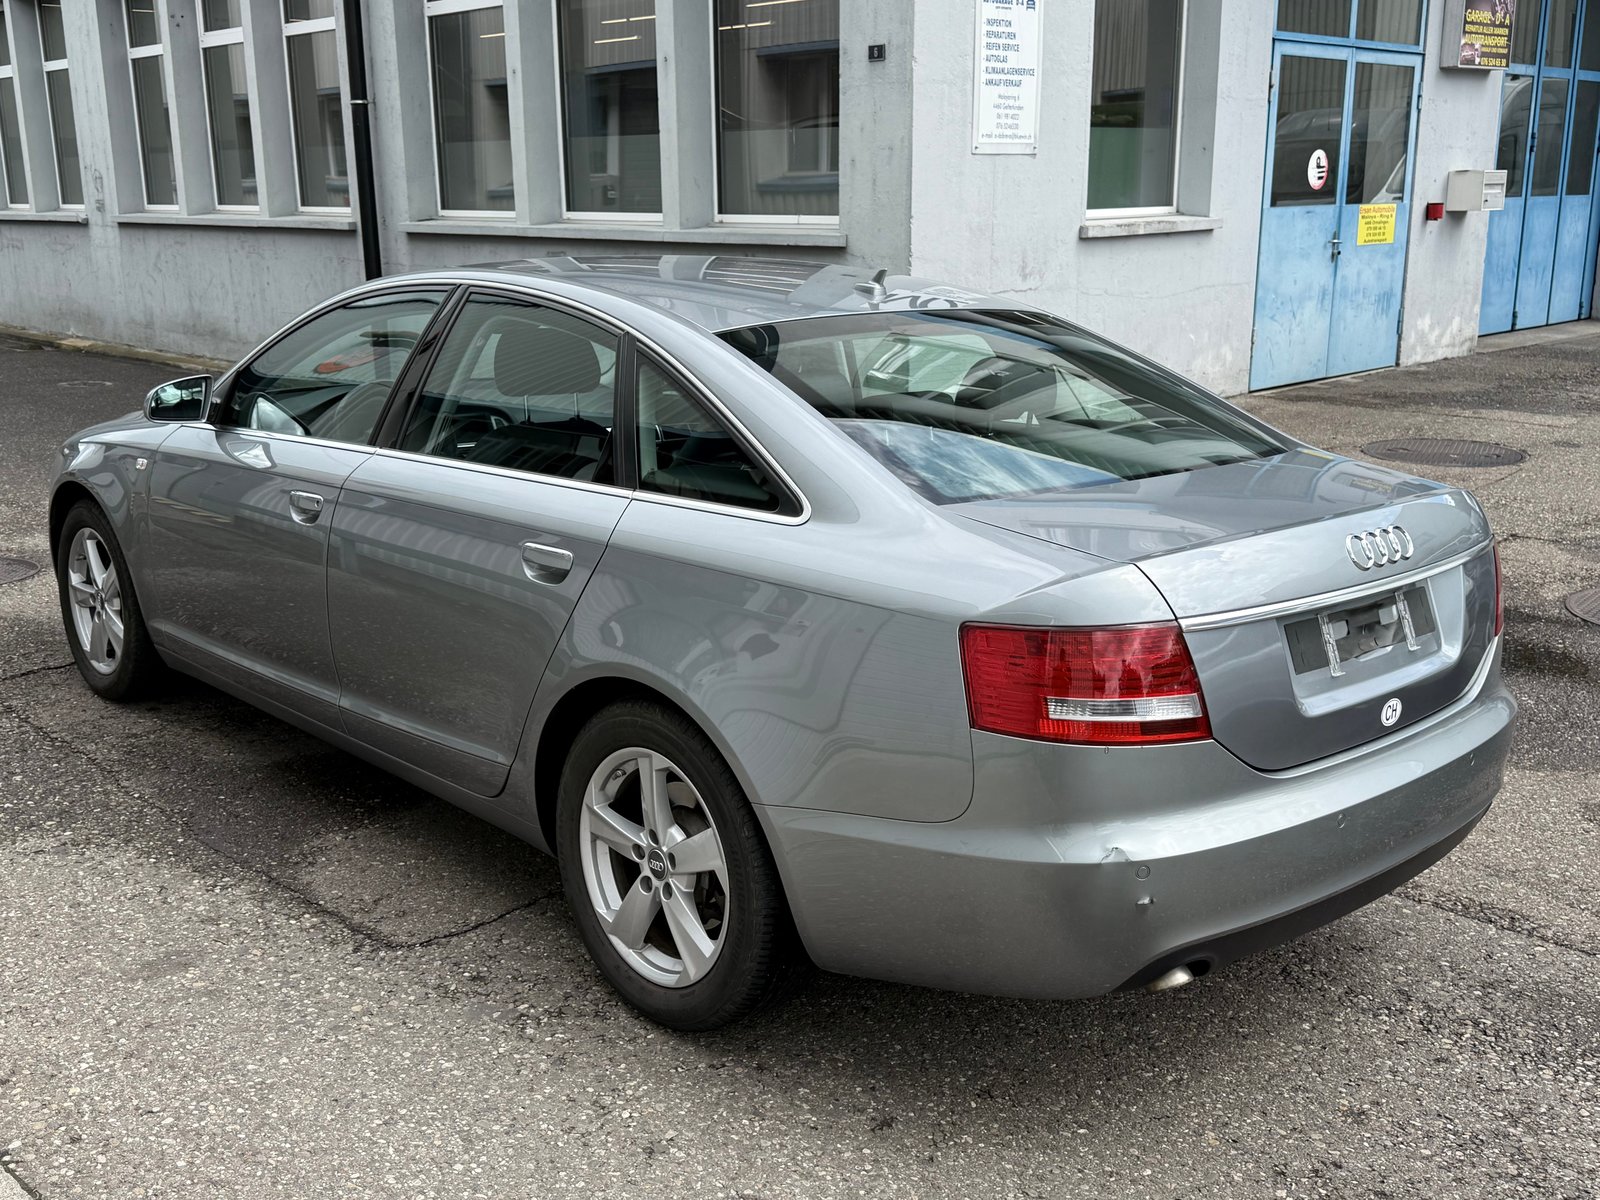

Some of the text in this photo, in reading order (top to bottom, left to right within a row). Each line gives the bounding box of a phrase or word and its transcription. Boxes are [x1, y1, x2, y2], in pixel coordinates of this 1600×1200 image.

[1466, 9, 1491, 23] GARAGE
[986, 18, 1012, 27] INSPEKTION
[986, 30, 1016, 40] REPARATUREN
[1465, 33, 1507, 47] AUTOTRANSPORT
[873, 47, 878, 57] 6
[986, 42, 1020, 52] REIFEN SERVICE
[985, 54, 1008, 63] AUTOGLAS
[985, 66, 1035, 76] KLIMAANLAGENSERVICE
[985, 78, 1022, 87] ANKAUF VERKAUF
[1385, 702, 1398, 721] CH
